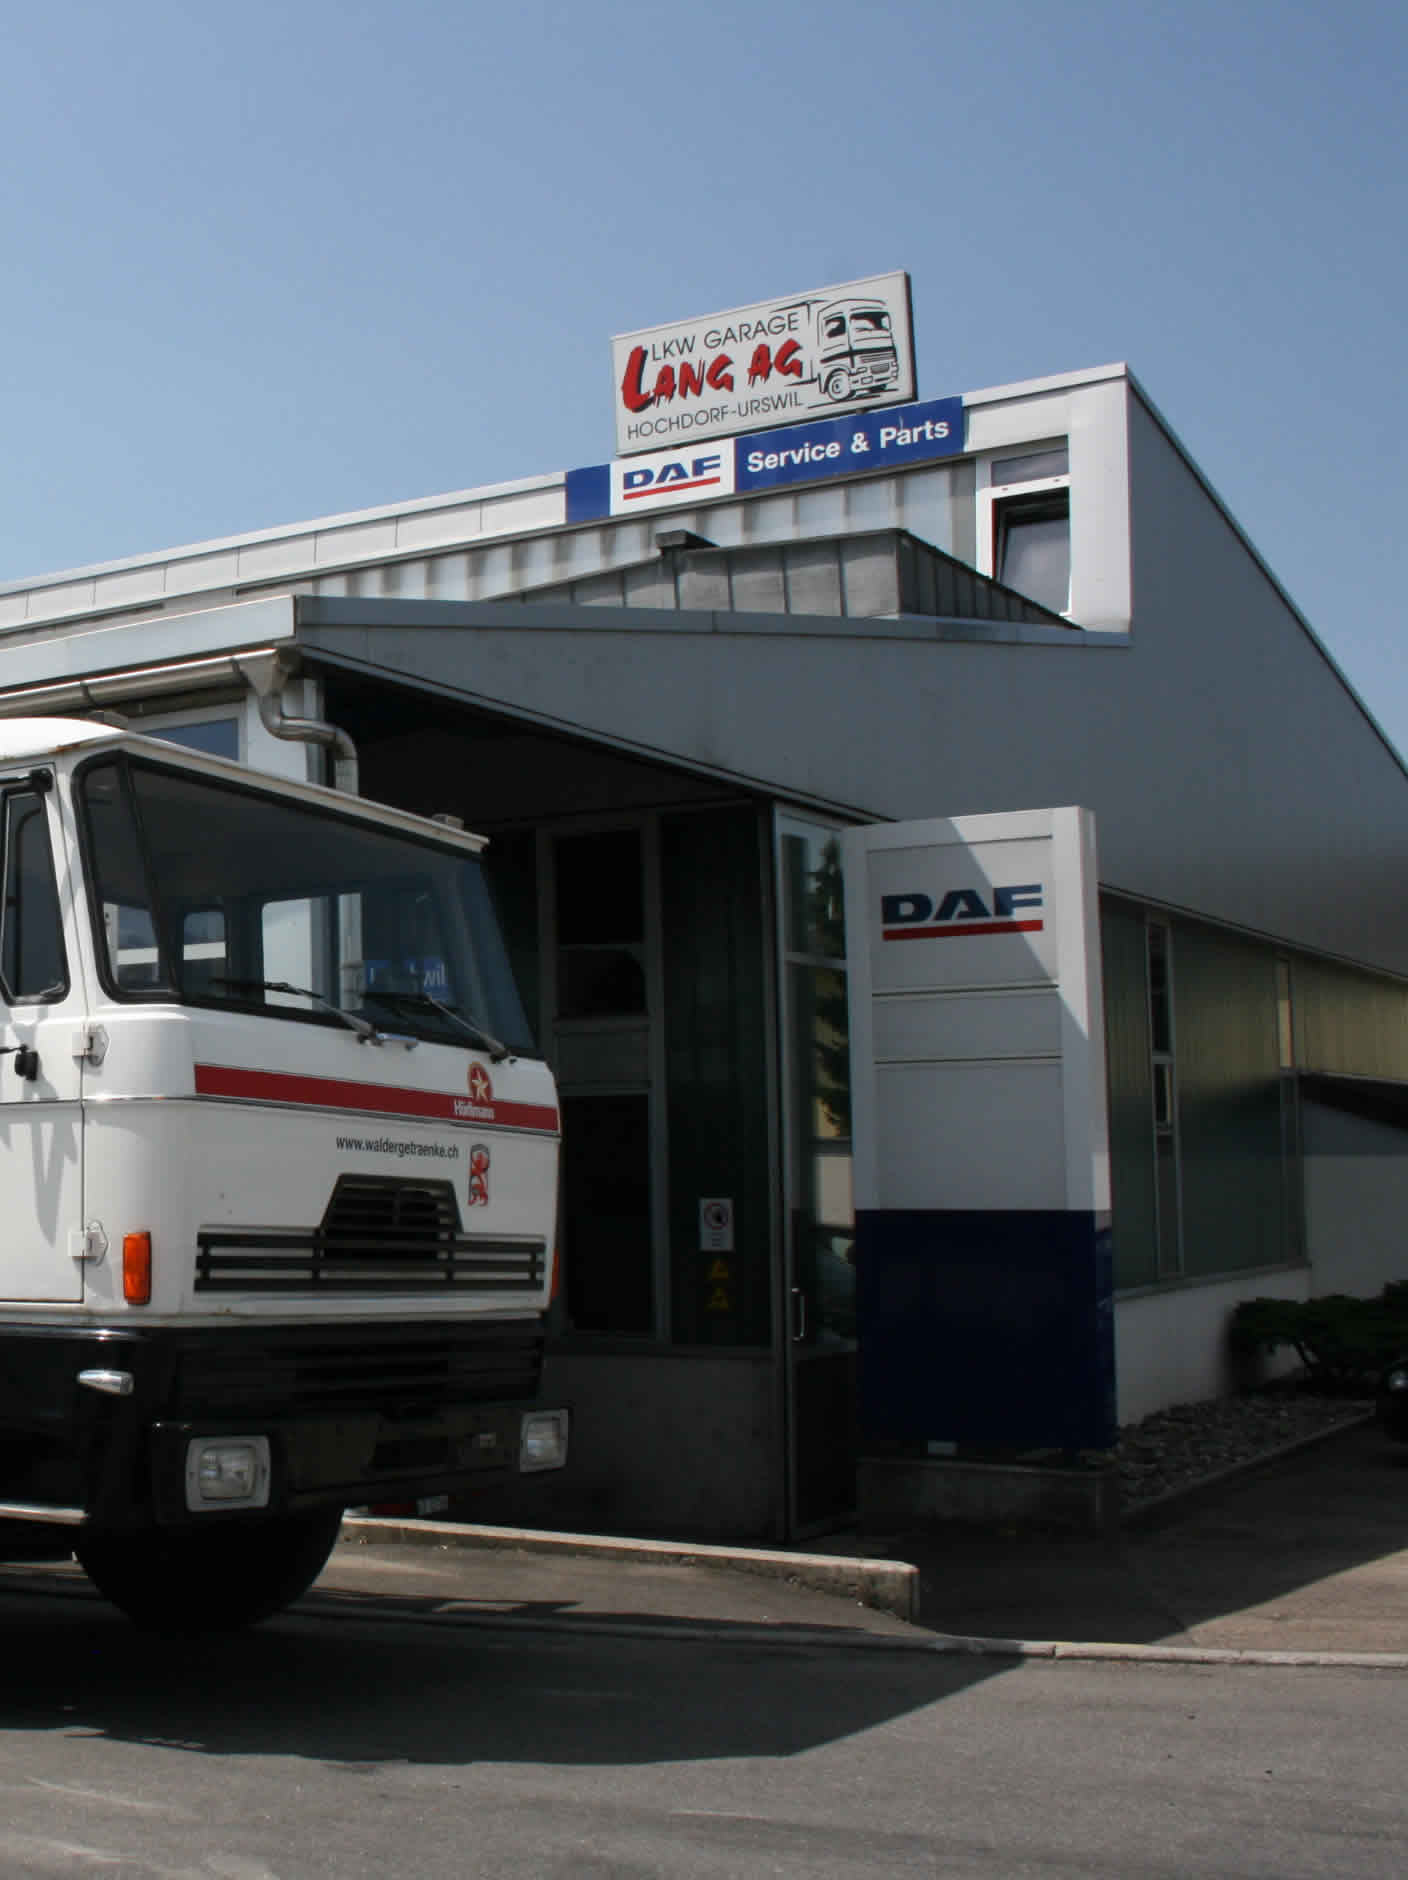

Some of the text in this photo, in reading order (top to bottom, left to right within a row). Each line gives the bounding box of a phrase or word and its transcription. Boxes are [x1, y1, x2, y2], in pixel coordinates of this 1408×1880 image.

[651, 312, 800, 362] LKW GARAGE
[620, 338, 804, 414] LANG AG
[626, 391, 804, 441] HOCHDORF-URSWIL
[747, 420, 950, 473] Service & Parts
[623, 454, 722, 490] DAF
[881, 883, 1042, 924] DAF
[336, 1136, 459, 1160] www.waldergetraenke.ch
